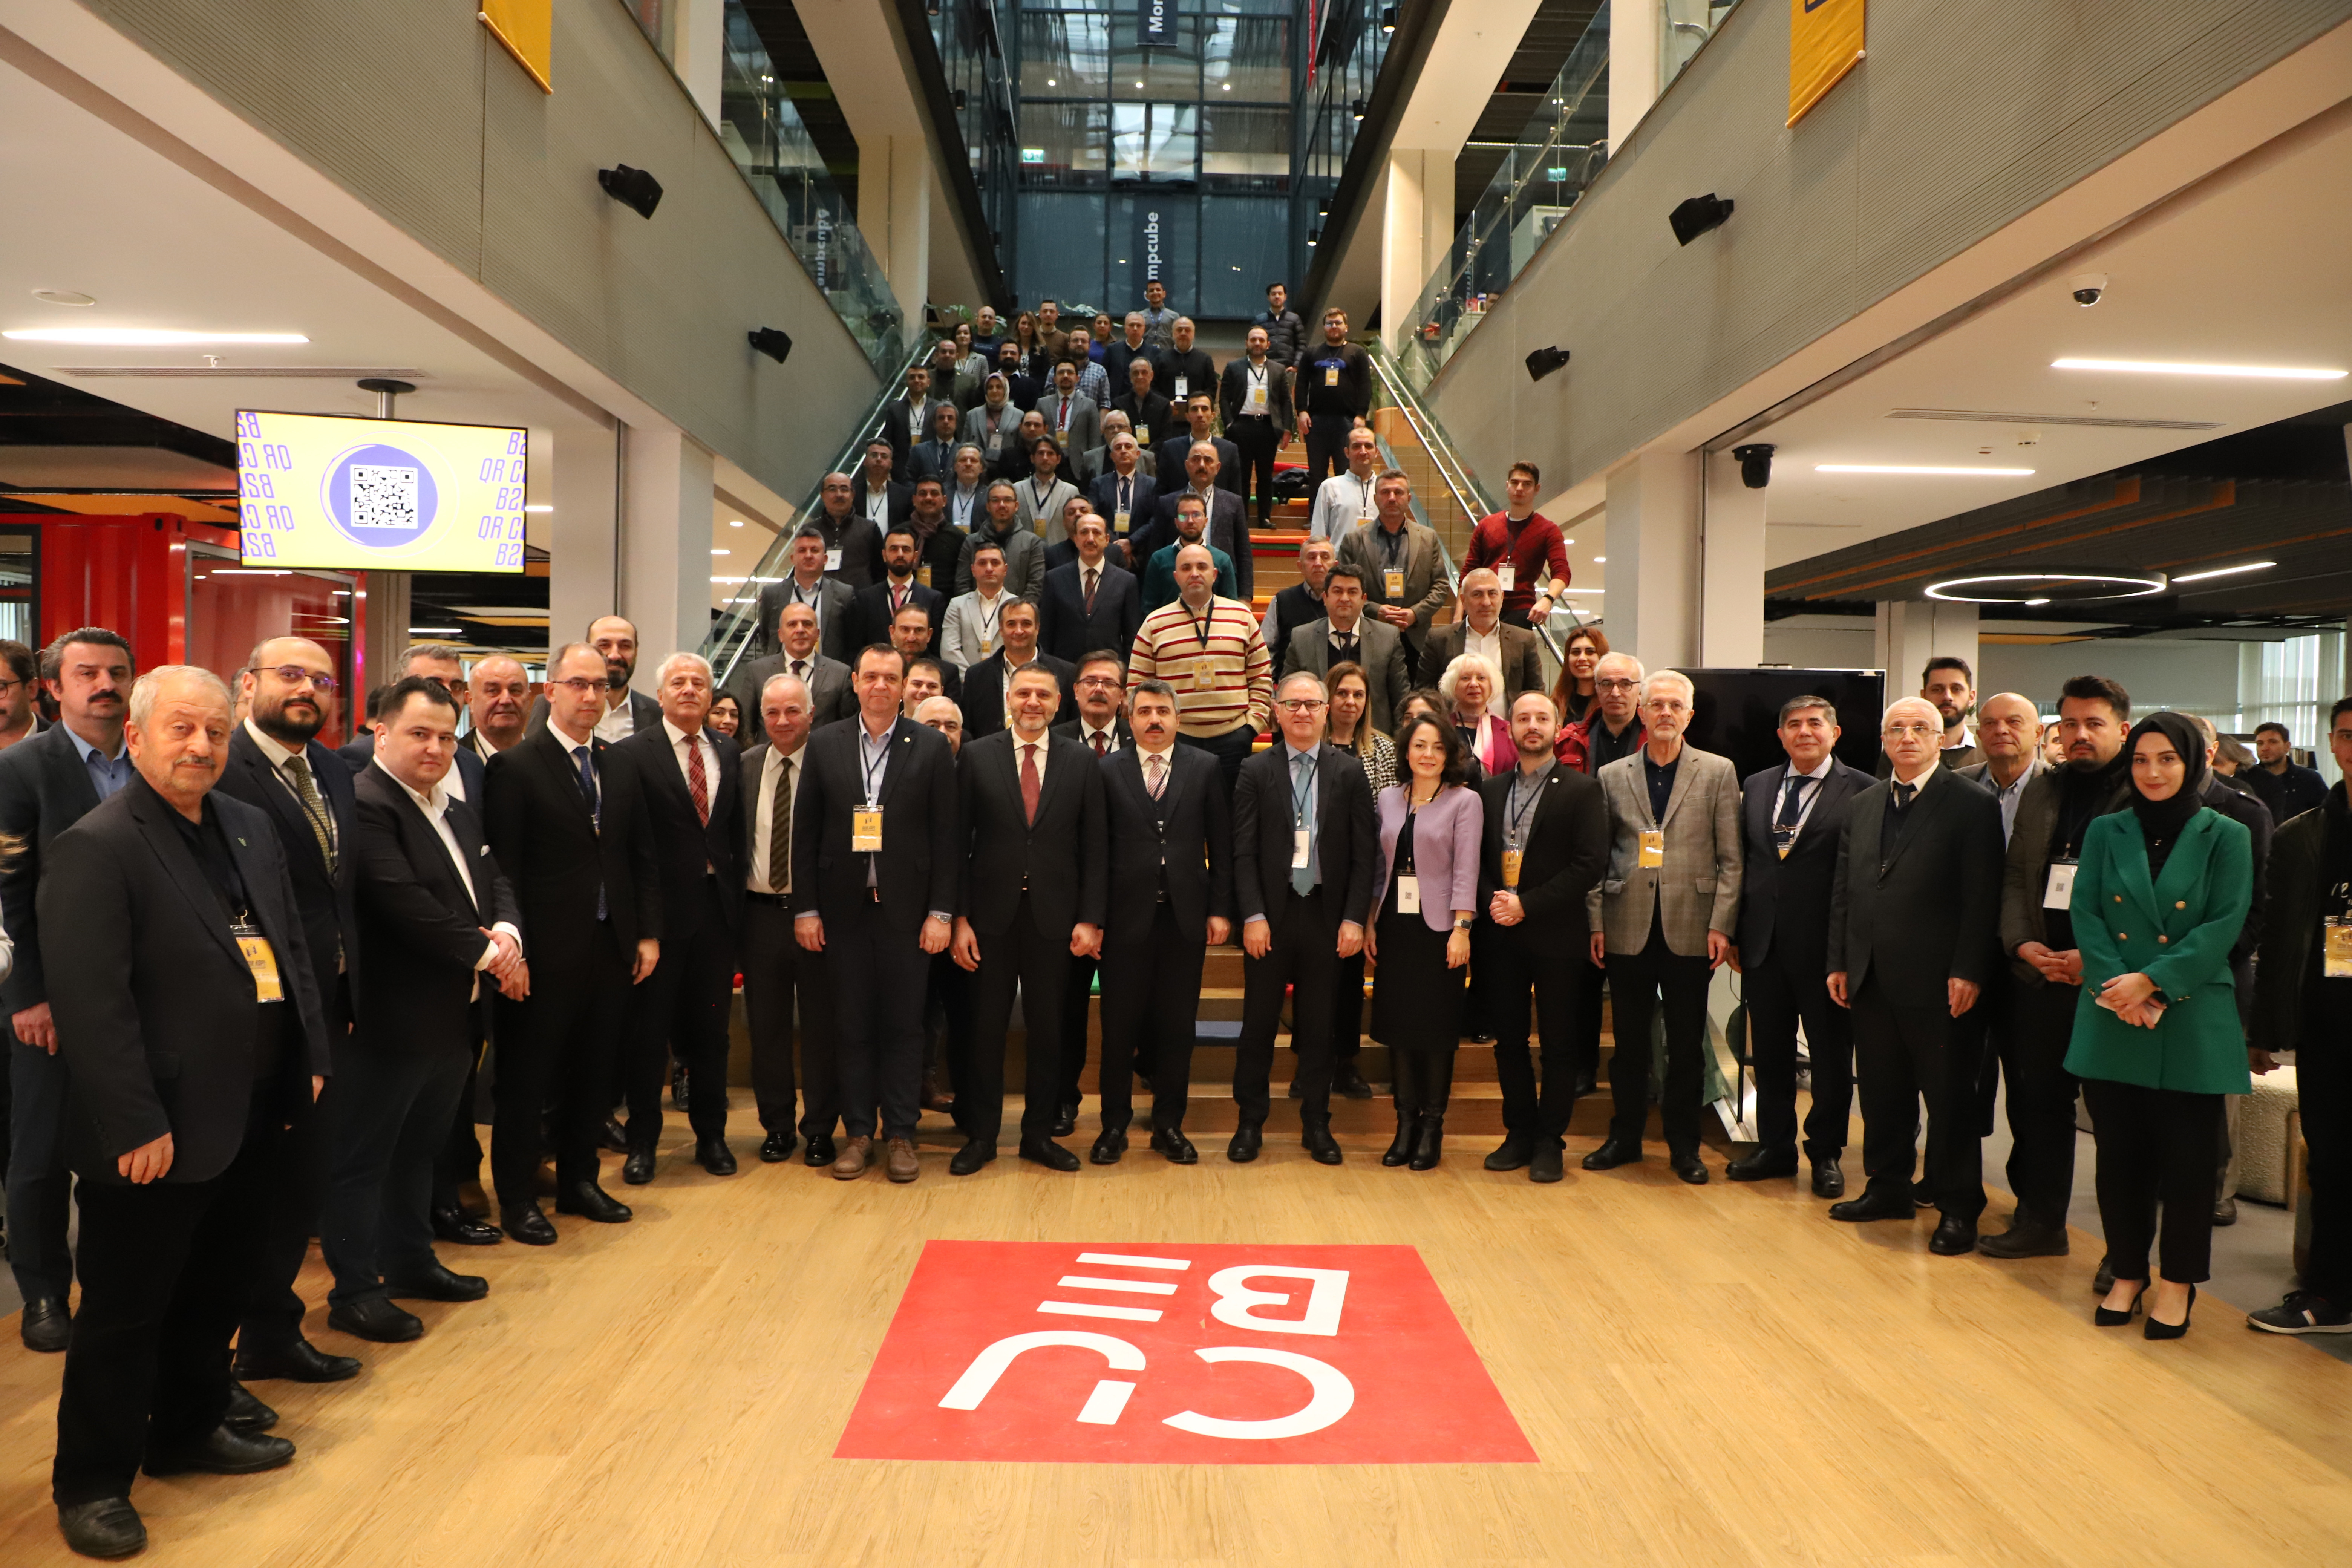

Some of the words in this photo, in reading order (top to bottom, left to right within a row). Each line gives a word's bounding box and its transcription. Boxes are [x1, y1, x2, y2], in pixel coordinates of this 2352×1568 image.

[1144, 211, 1162, 301] mpcube
[479, 458, 505, 483] QR
[510, 459, 525, 484] C
[496, 487, 525, 511] B2
[478, 515, 504, 541] QR
[508, 517, 524, 540] C
[495, 543, 524, 566] B2
